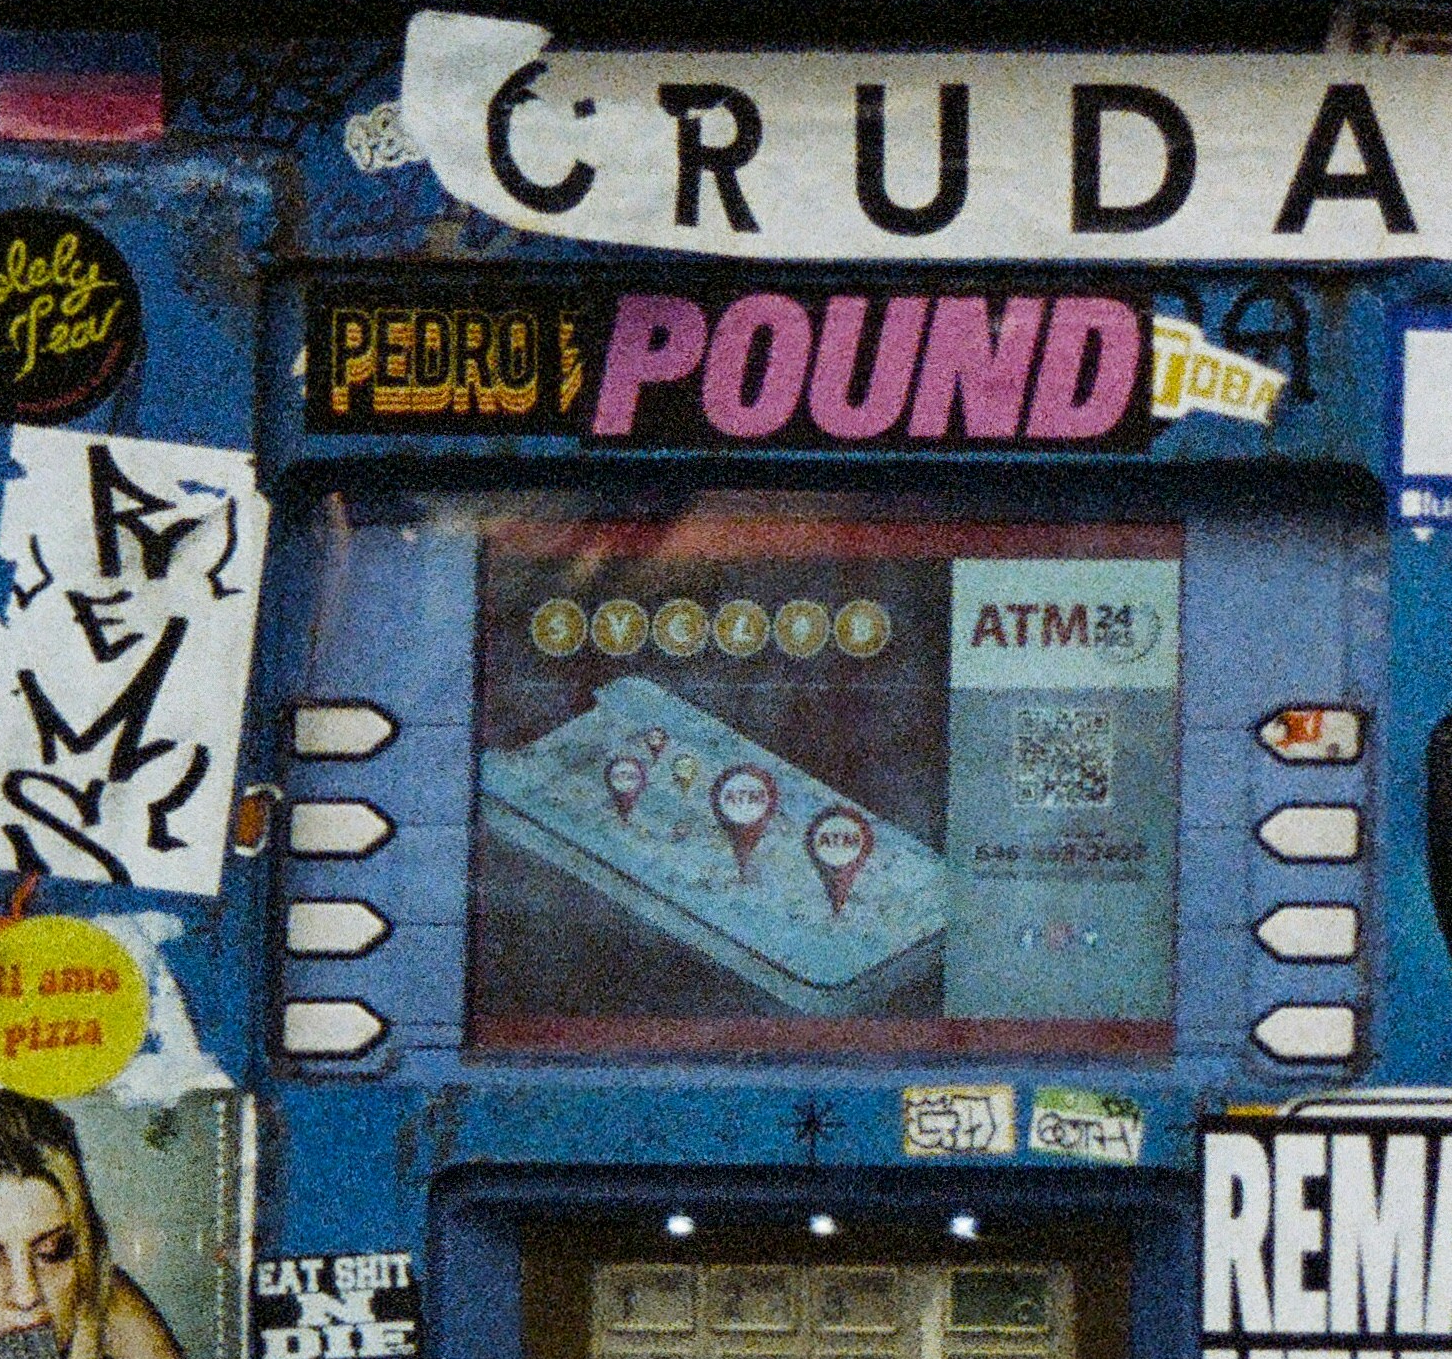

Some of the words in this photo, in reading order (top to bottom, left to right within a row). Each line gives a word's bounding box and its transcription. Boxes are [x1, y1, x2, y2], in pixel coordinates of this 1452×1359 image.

[485, 56, 1424, 238] CRUDA
[331, 305, 540, 414] PEDRO
[590, 290, 1148, 442] POUND
[971, 603, 1092, 650] ATM
[3, 1018, 104, 1056] pizza
[256, 1259, 321, 1297] EAT
[333, 1252, 414, 1291] SHIT
[297, 1292, 375, 1325] N
